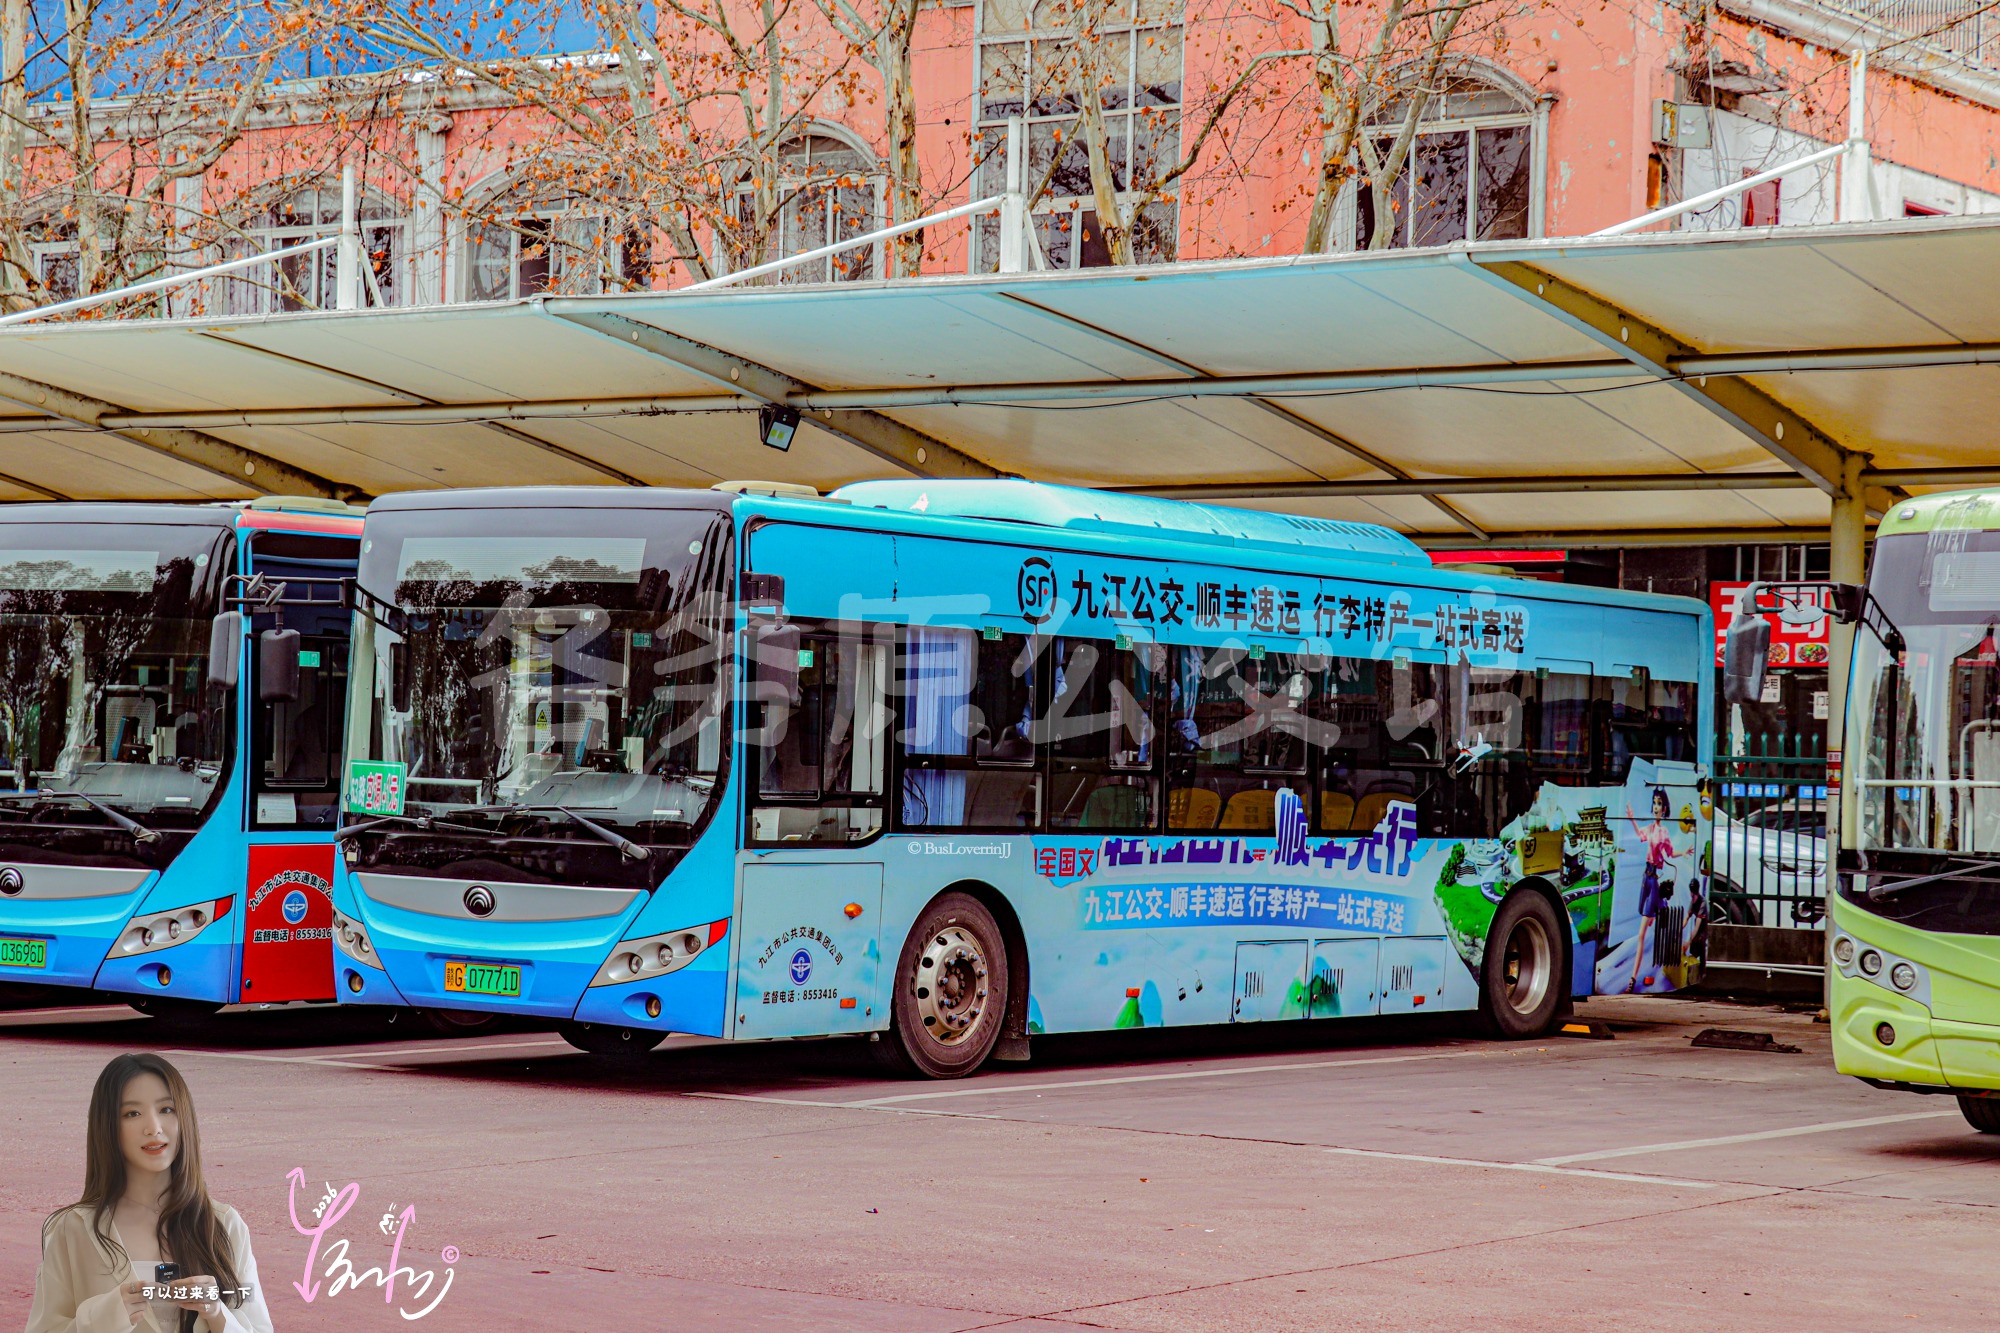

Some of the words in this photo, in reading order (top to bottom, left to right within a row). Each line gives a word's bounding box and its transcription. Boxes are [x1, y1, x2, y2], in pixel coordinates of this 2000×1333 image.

[1026, 575, 1050, 607] SF
[1071, 569, 1300, 634] 九江公交-顺丰速运
[1313, 592, 1525, 654] 行李特产一站式寄送
[1085, 885, 1244, 924] 九江公交-顺丰速运
[1249, 887, 1405, 934] 行李特产一站式寄送
[1, 943, 44, 964] 03696D
[758, 926, 844, 969] 九江市公共交通集团公司
